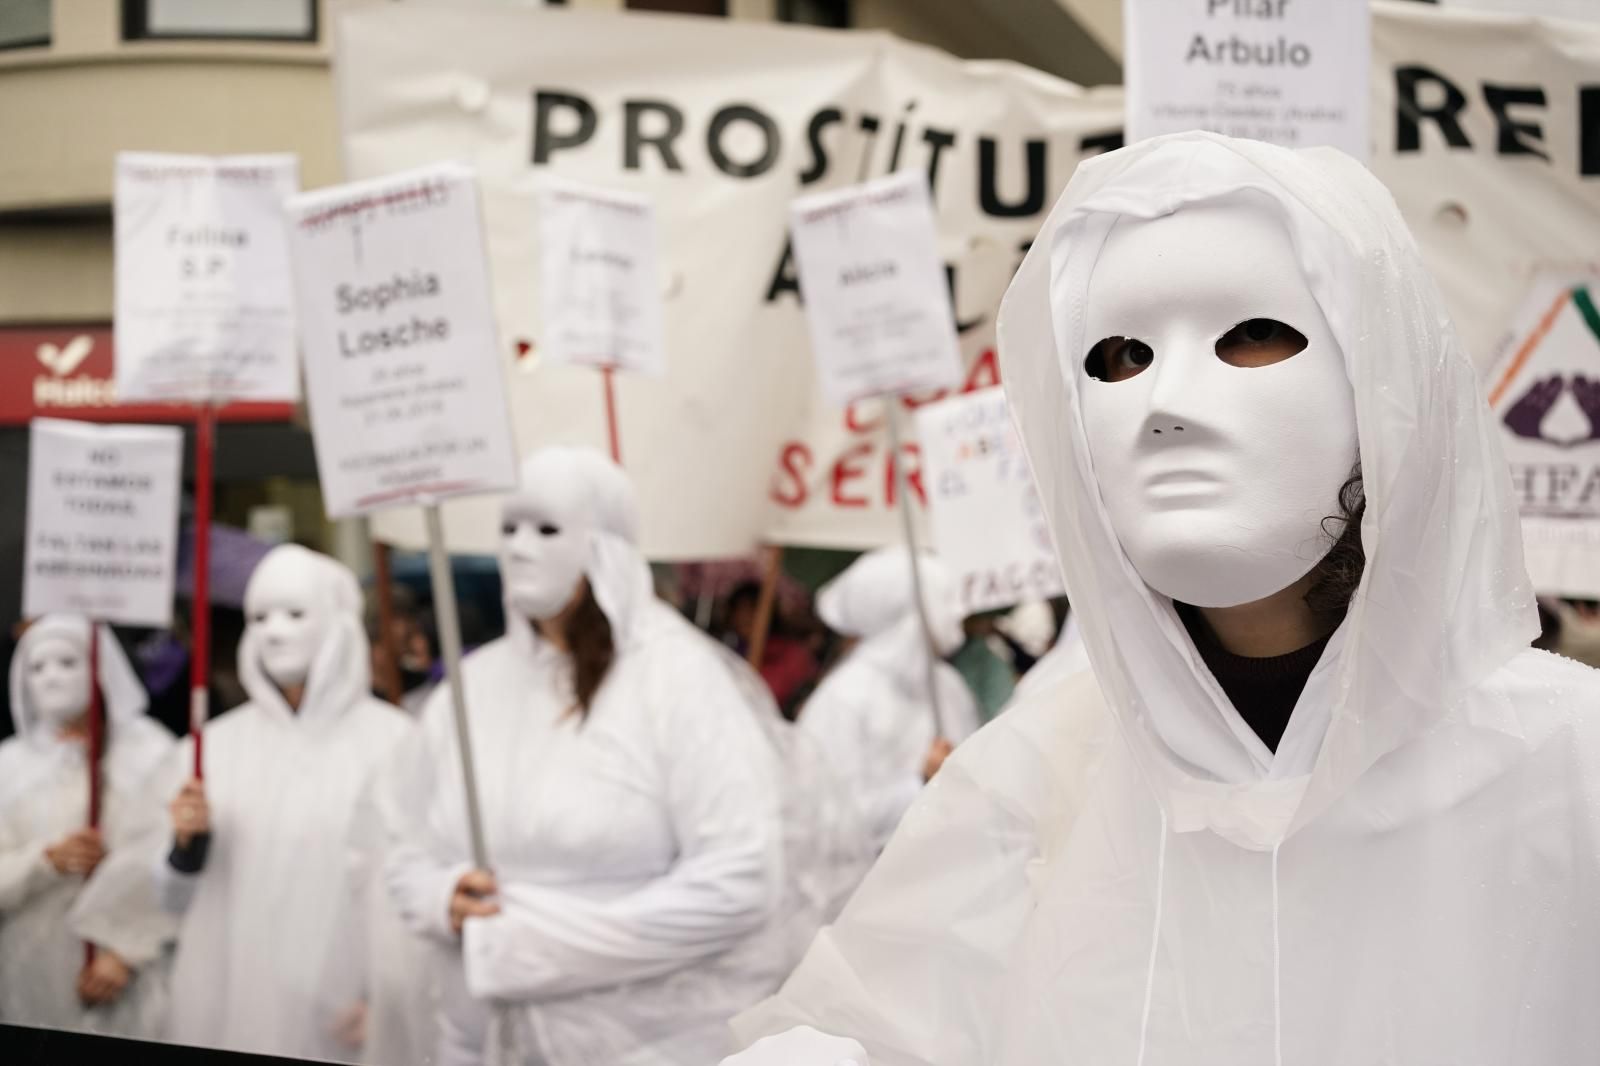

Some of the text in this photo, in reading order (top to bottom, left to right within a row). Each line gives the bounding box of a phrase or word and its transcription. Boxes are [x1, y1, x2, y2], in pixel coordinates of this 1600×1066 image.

[1185, 34, 1312, 67] Arbulo
[335, 270, 441, 314] Sophia
[338, 317, 449, 358] Losche
